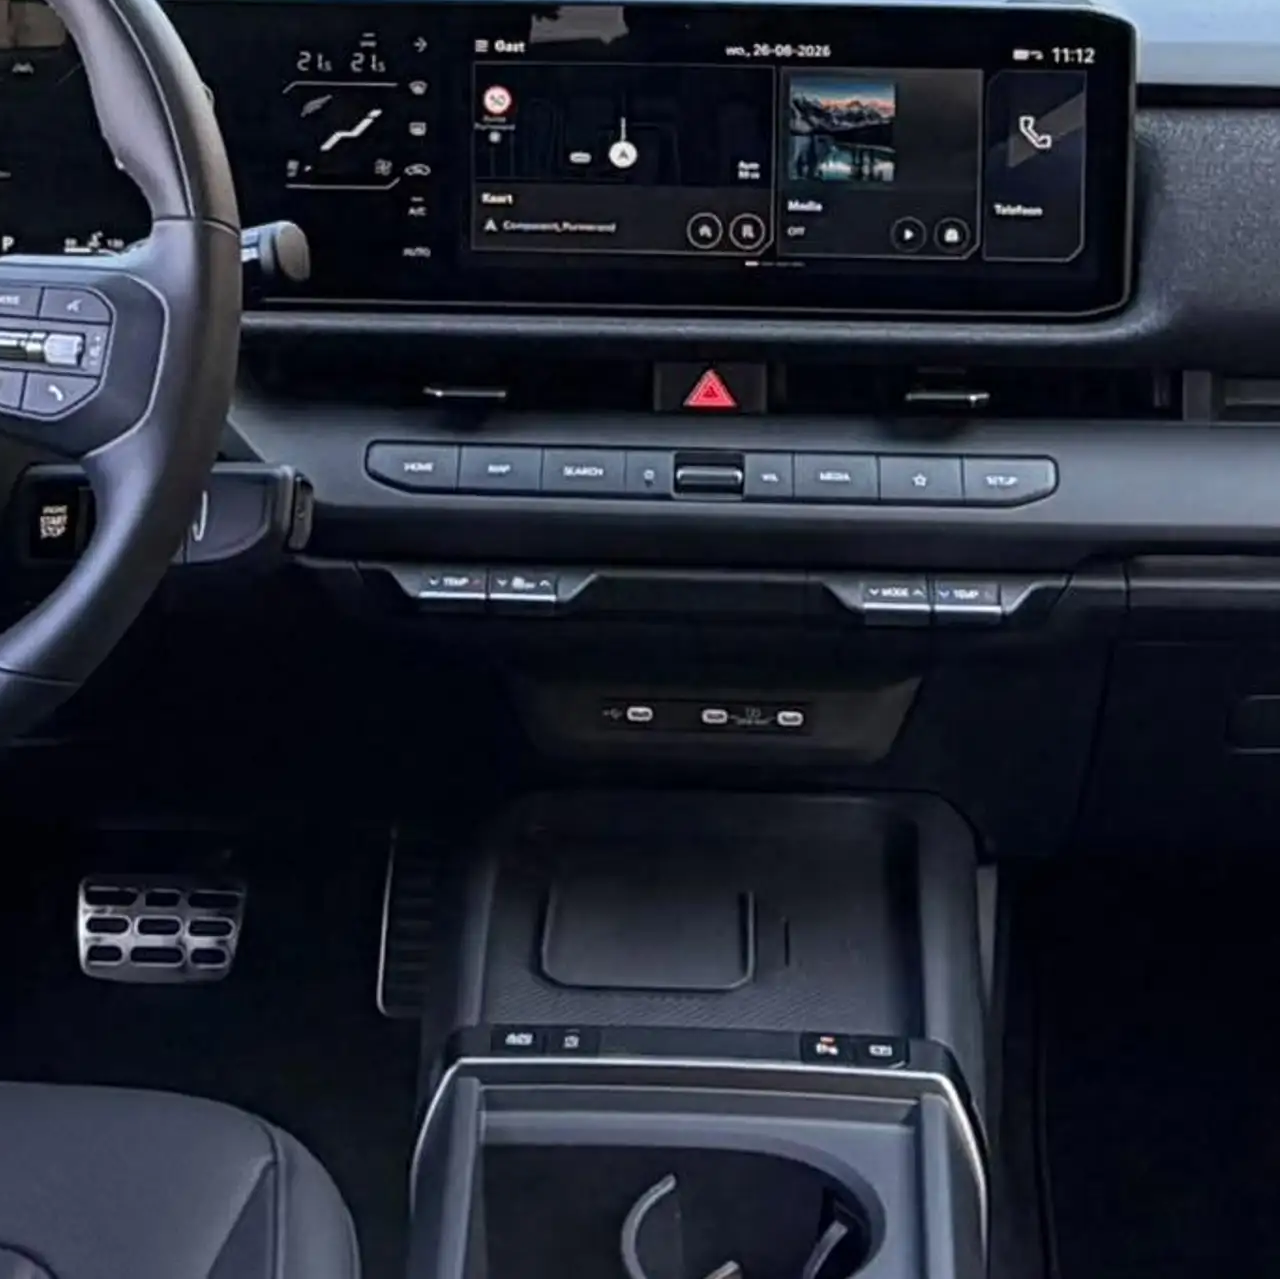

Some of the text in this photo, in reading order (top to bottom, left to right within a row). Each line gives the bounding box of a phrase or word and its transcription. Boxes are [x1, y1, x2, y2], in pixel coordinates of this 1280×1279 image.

[494, 39, 525, 53] Gast
[1051, 47, 1096, 64] 11:12
[482, 192, 513, 205] Kaart
[787, 200, 823, 213] Media
[994, 202, 1044, 216] Telefoon
[2, 236, 15, 252] P
[563, 466, 604, 477] SEARCH
